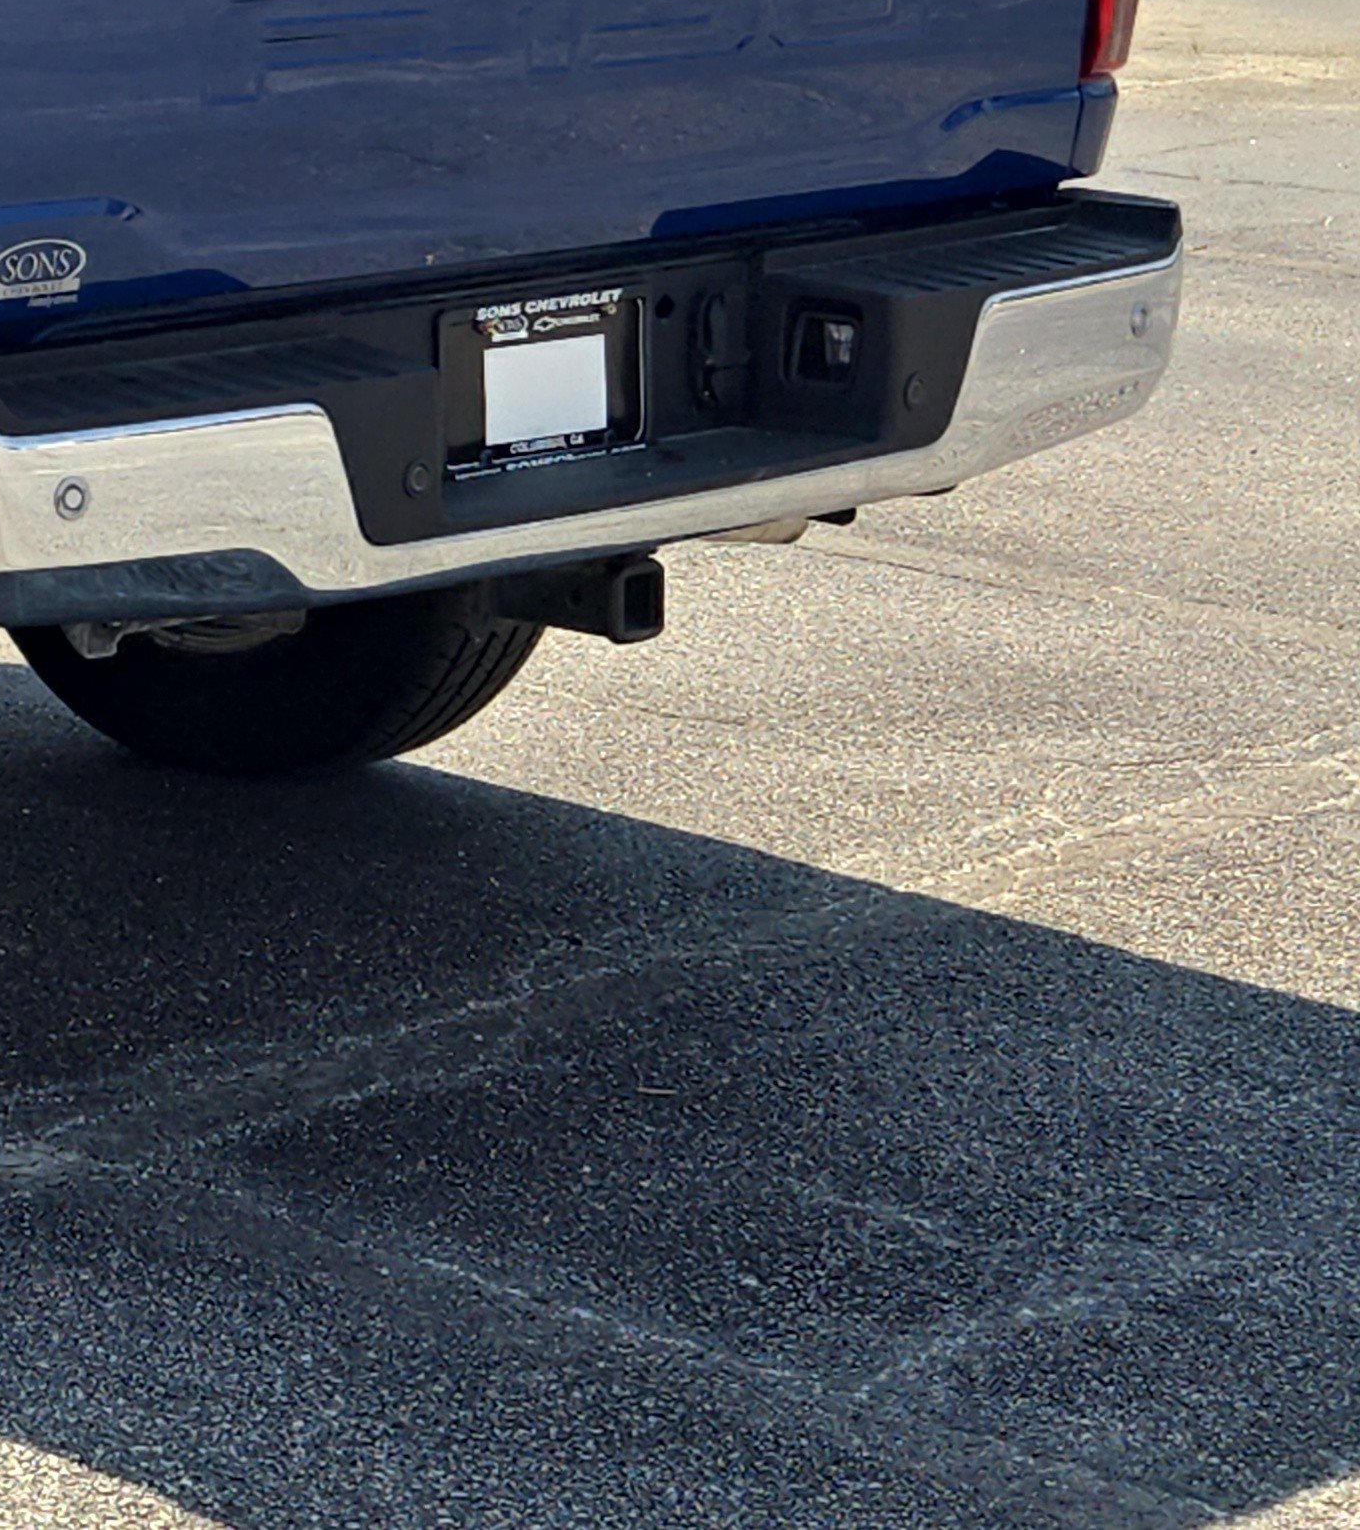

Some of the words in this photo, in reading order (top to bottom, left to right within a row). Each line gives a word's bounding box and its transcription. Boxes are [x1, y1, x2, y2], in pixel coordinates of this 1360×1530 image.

[0, 249, 73, 283] SONS
[476, 301, 522, 321] SONS
[524, 288, 622, 314] CHEVROLET
